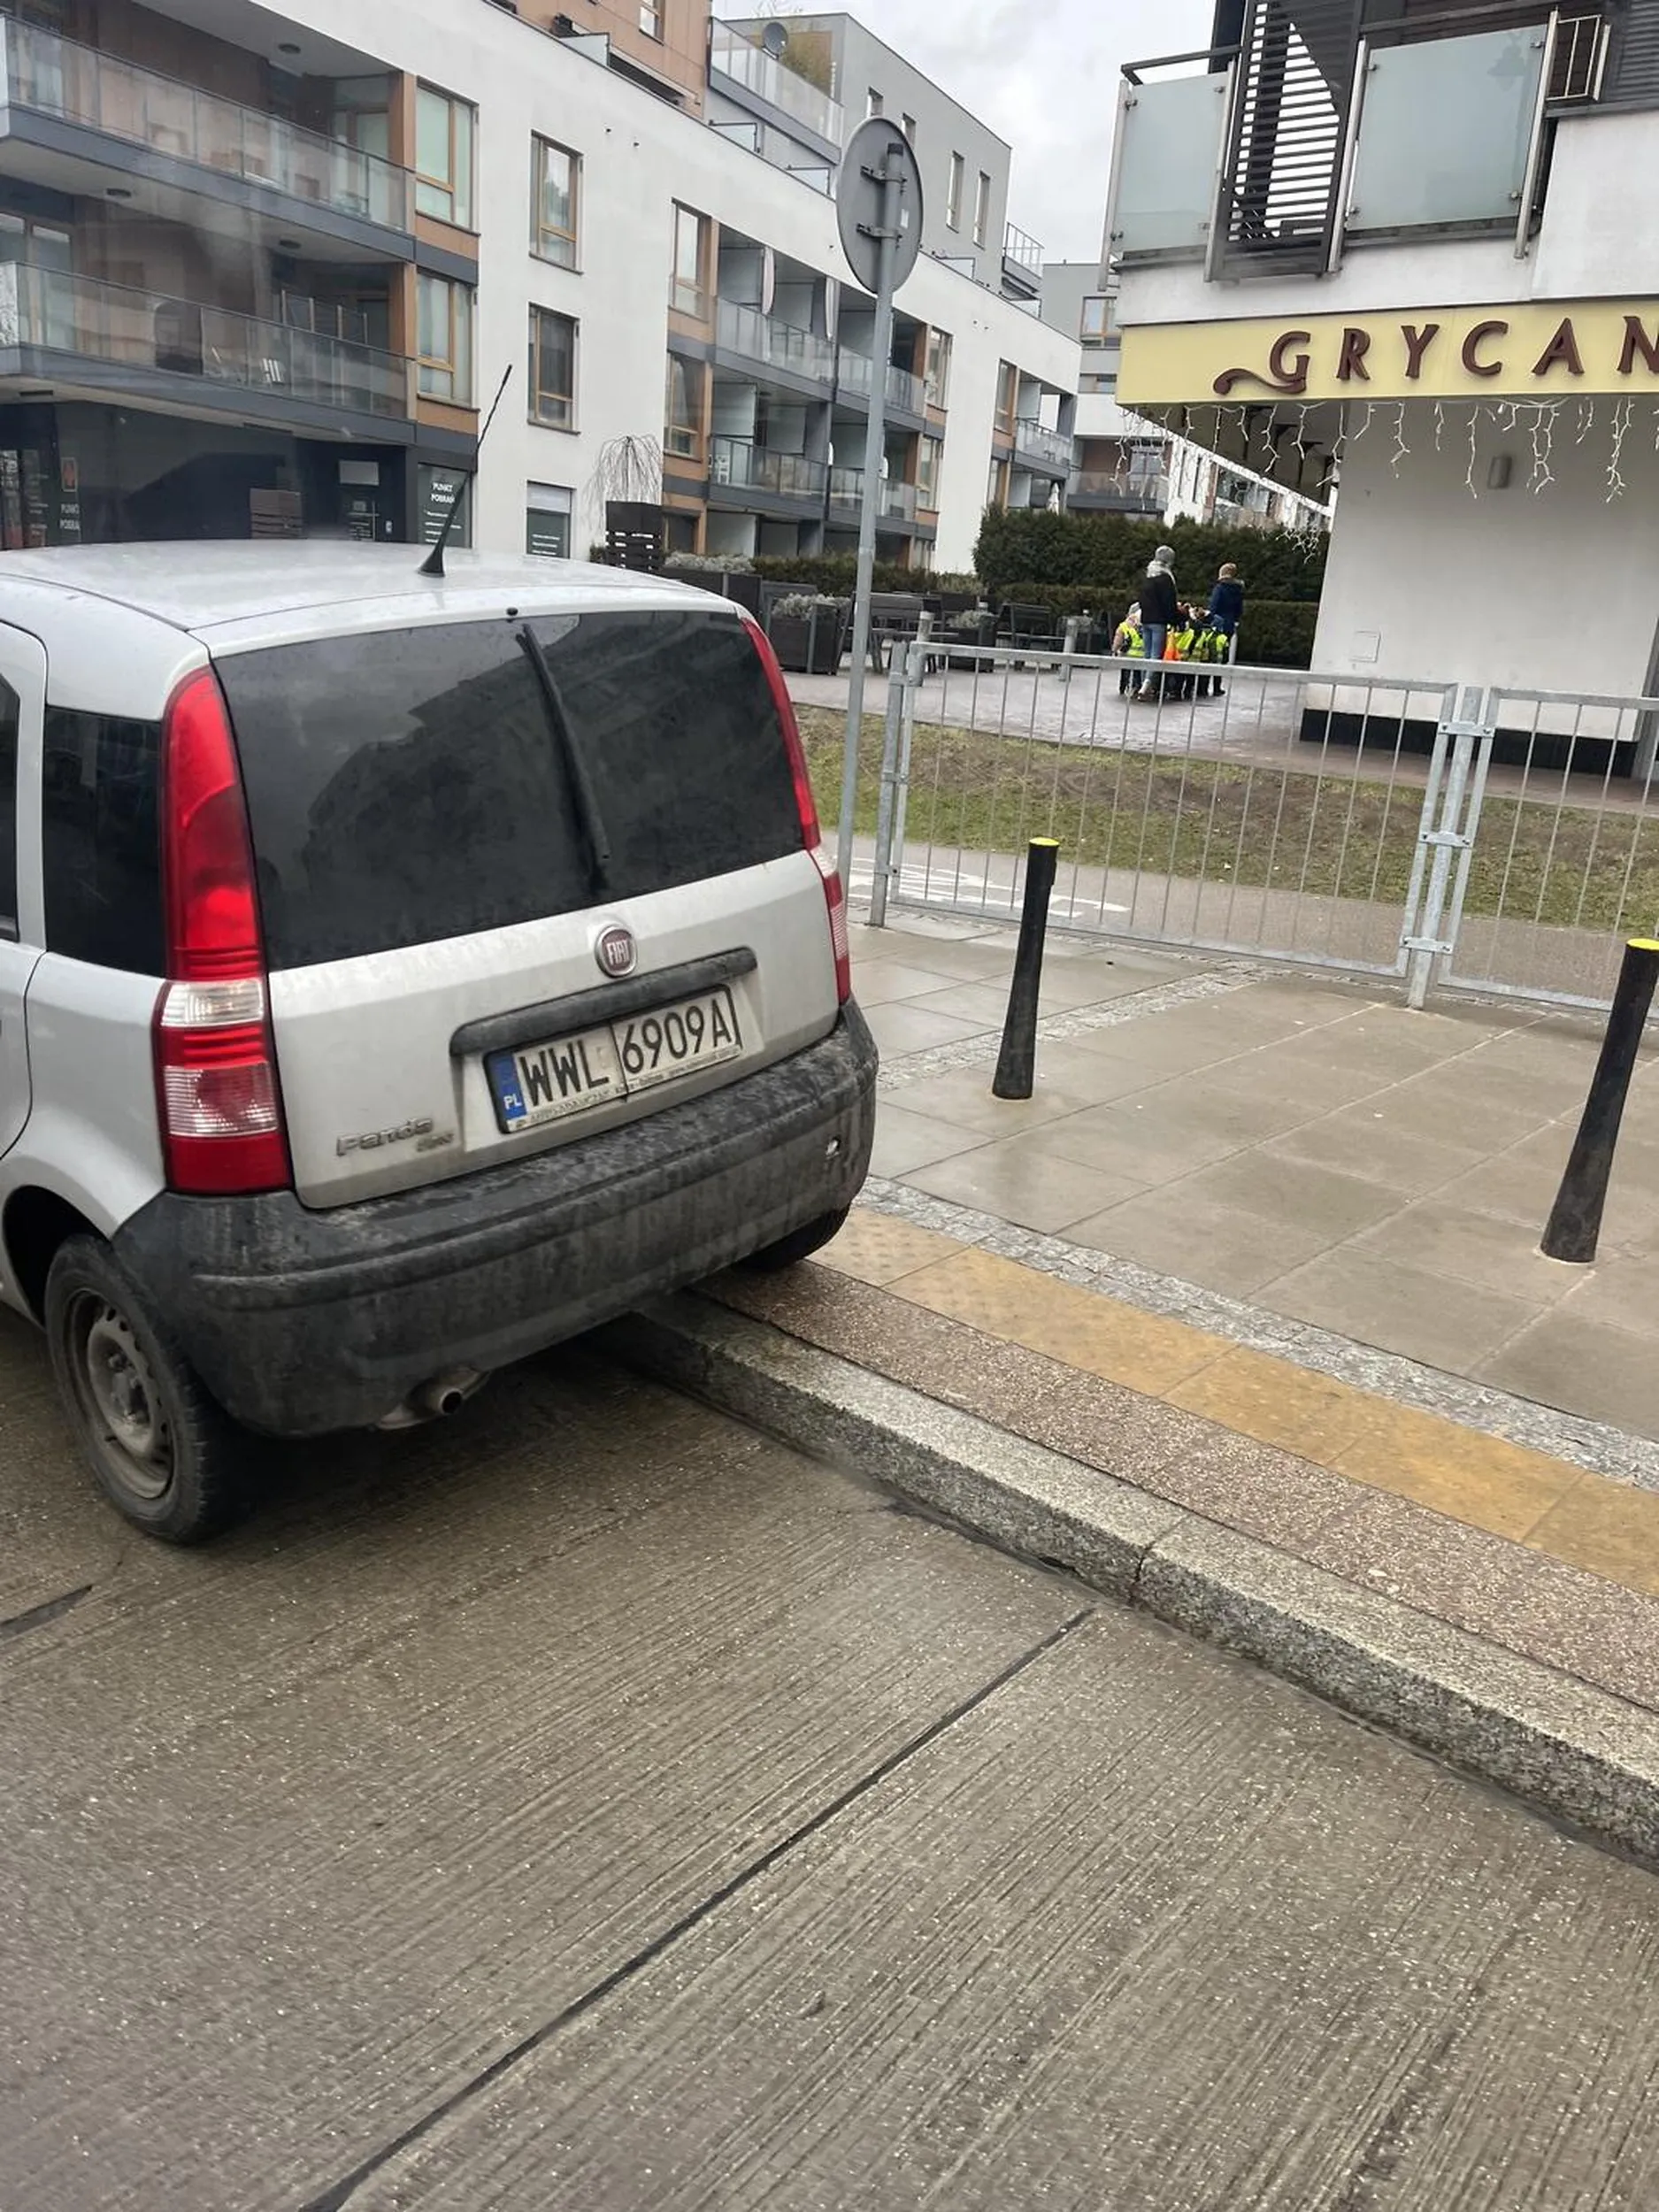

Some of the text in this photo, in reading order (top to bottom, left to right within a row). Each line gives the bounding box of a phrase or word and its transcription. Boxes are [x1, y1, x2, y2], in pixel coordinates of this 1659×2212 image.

[606, 939, 629, 966] FIAT
[518, 1039, 610, 1107] WWL
[621, 998, 733, 1074] 6909A
[503, 1093, 523, 1110] PL
[335, 1117, 433, 1157] Panda
